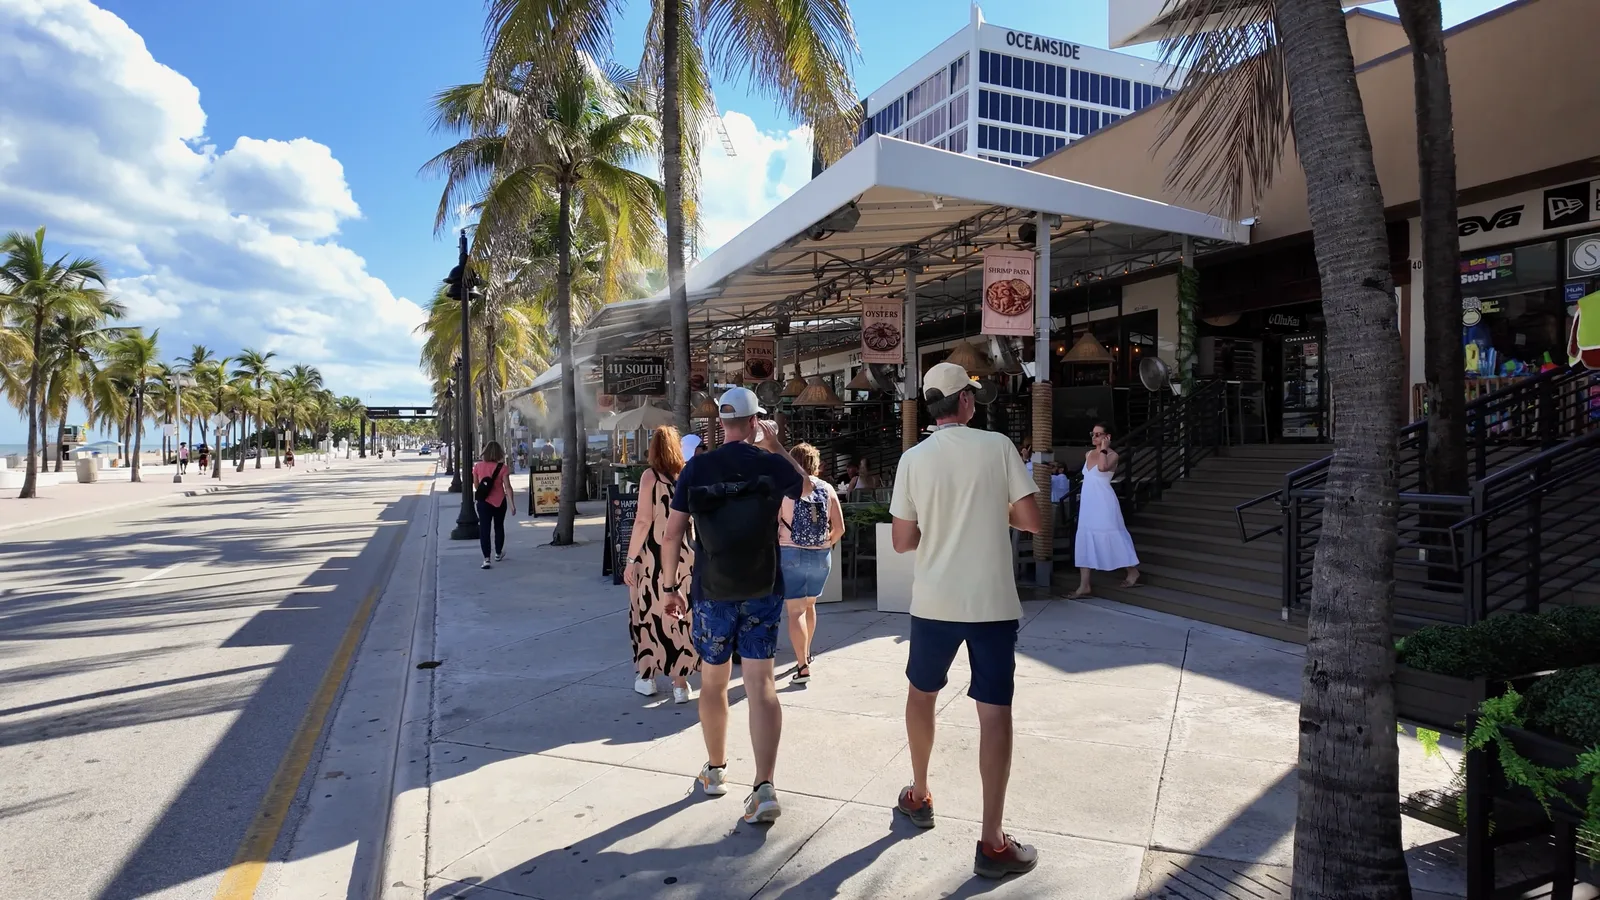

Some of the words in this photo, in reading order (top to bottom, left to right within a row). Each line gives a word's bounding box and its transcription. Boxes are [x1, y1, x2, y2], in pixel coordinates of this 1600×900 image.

[1006, 31, 1080, 60] OCEANSIDE
[1457, 205, 1524, 236] eva
[988, 267, 1012, 275] SHRIMP
[1013, 268, 1031, 276] PASTA
[1460, 269, 1496, 284] Swirl
[865, 310, 898, 318] OYSTERS
[747, 347, 772, 355] STEAK
[606, 363, 623, 374] 411
[625, 363, 663, 374] SOUTH
